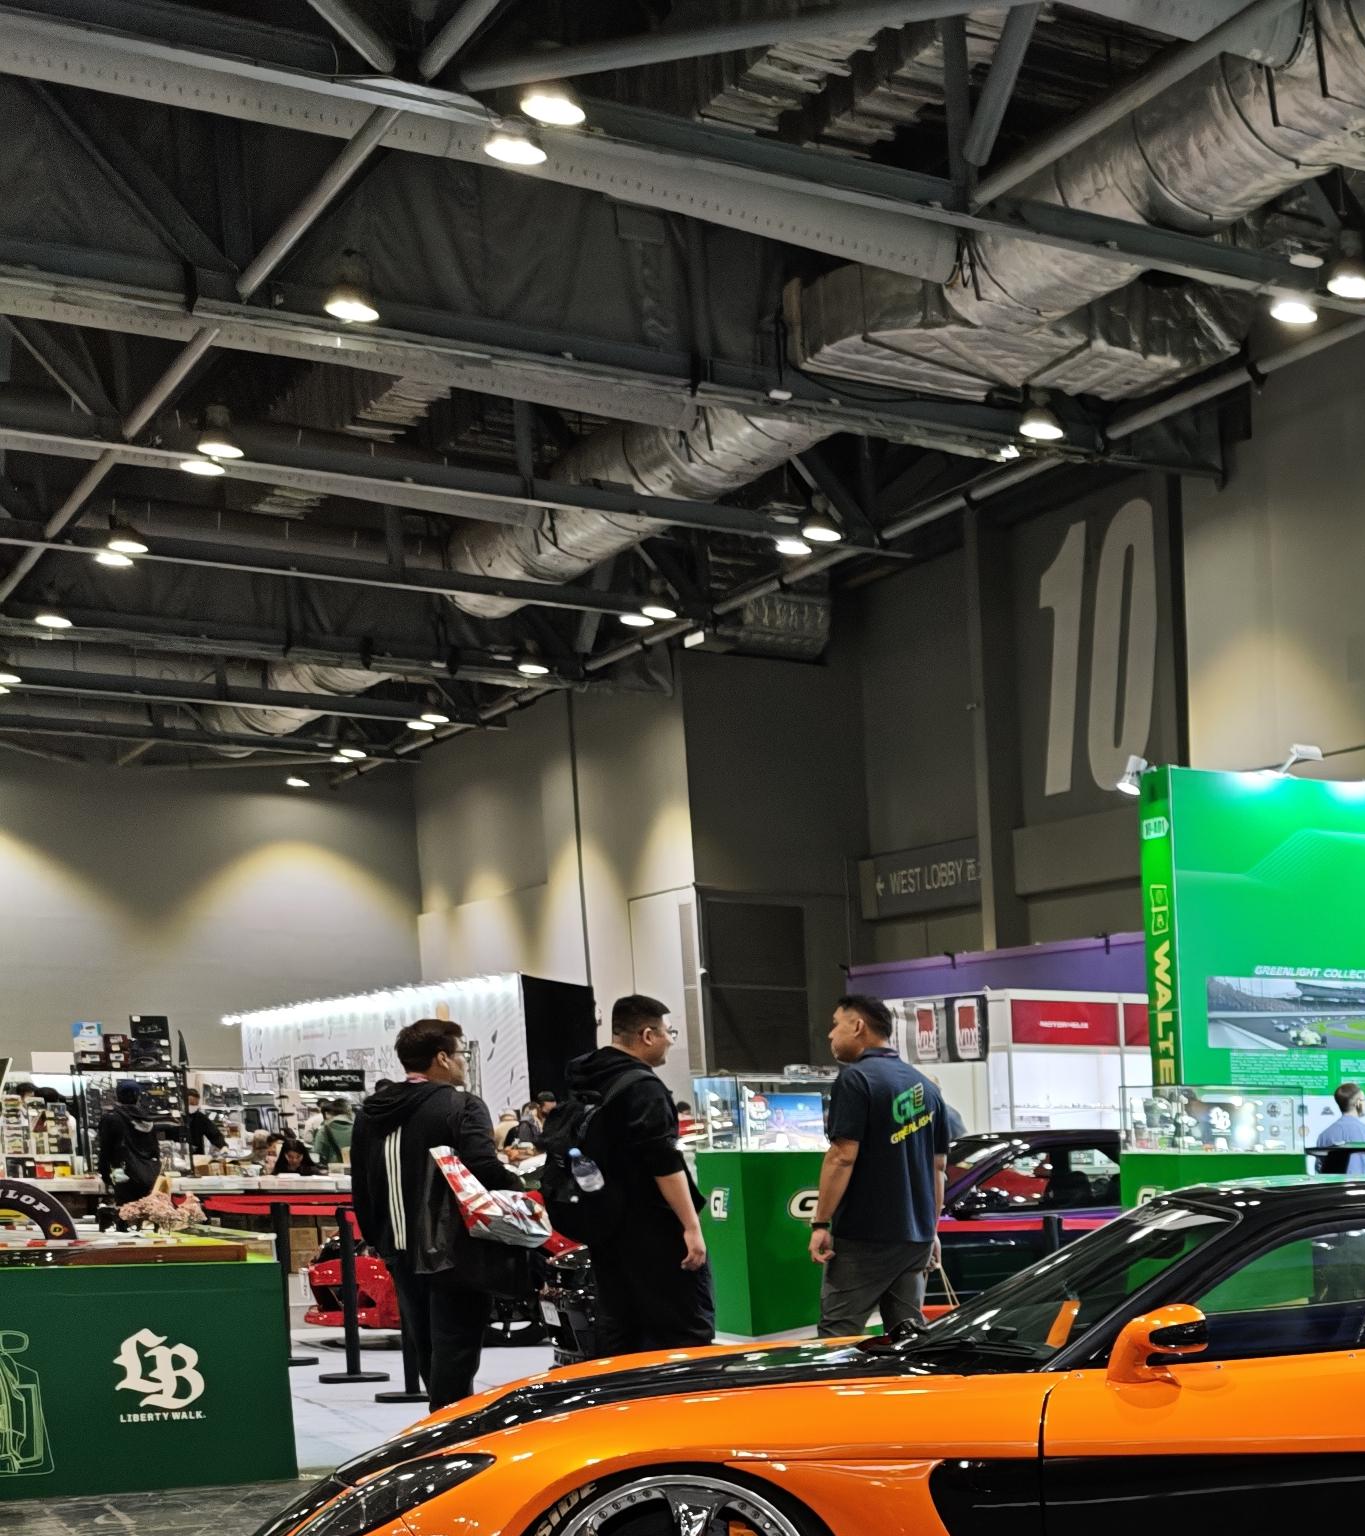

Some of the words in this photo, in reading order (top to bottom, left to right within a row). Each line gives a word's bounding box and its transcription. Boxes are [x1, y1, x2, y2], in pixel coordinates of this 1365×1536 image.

[1039, 499, 1157, 797] 10
[889, 867, 920, 896] WEST
[924, 860, 963, 890] LOBBY
[1254, 965, 1320, 979] GREENLIGHT
[120, 1412, 169, 1423] LIBERTY
